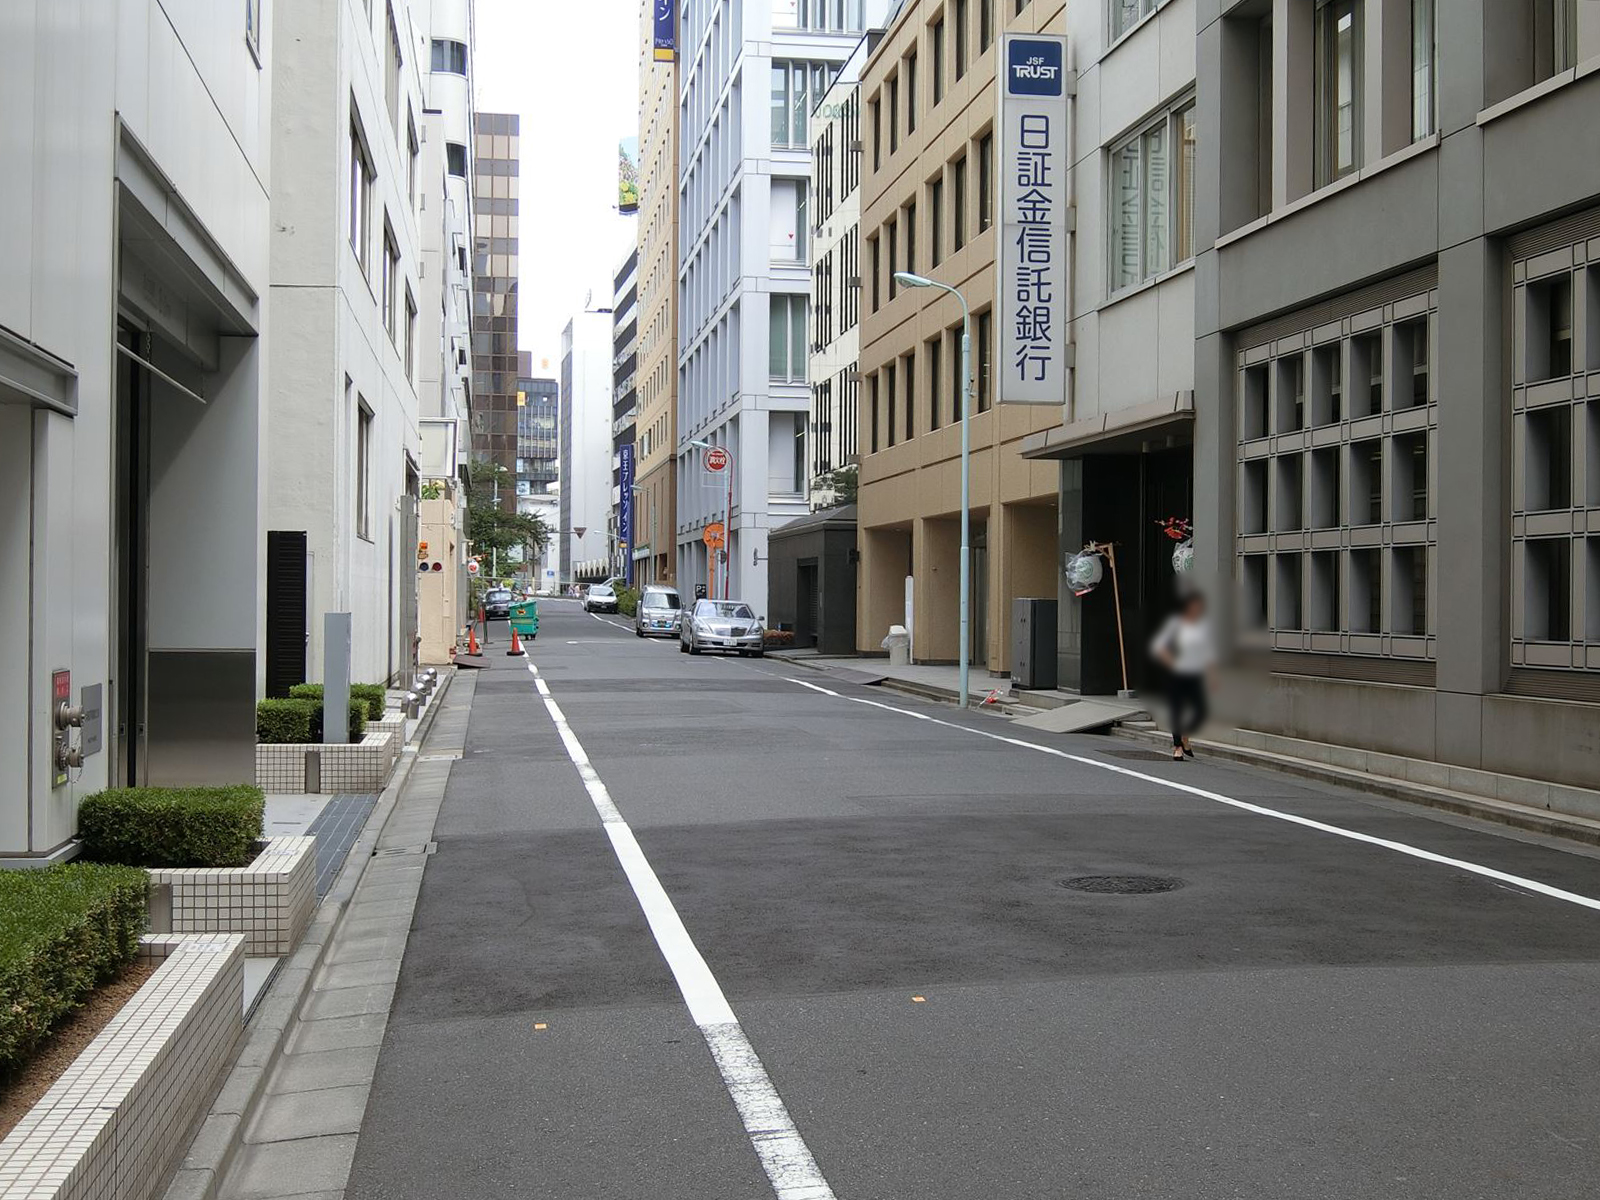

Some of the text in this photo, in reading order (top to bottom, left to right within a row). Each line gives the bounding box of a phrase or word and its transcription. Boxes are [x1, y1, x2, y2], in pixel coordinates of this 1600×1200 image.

[1026, 56, 1045, 65] JSF
[1012, 65, 1059, 79] TRUST
[1015, 114, 1053, 381] 日証金信託銀行
